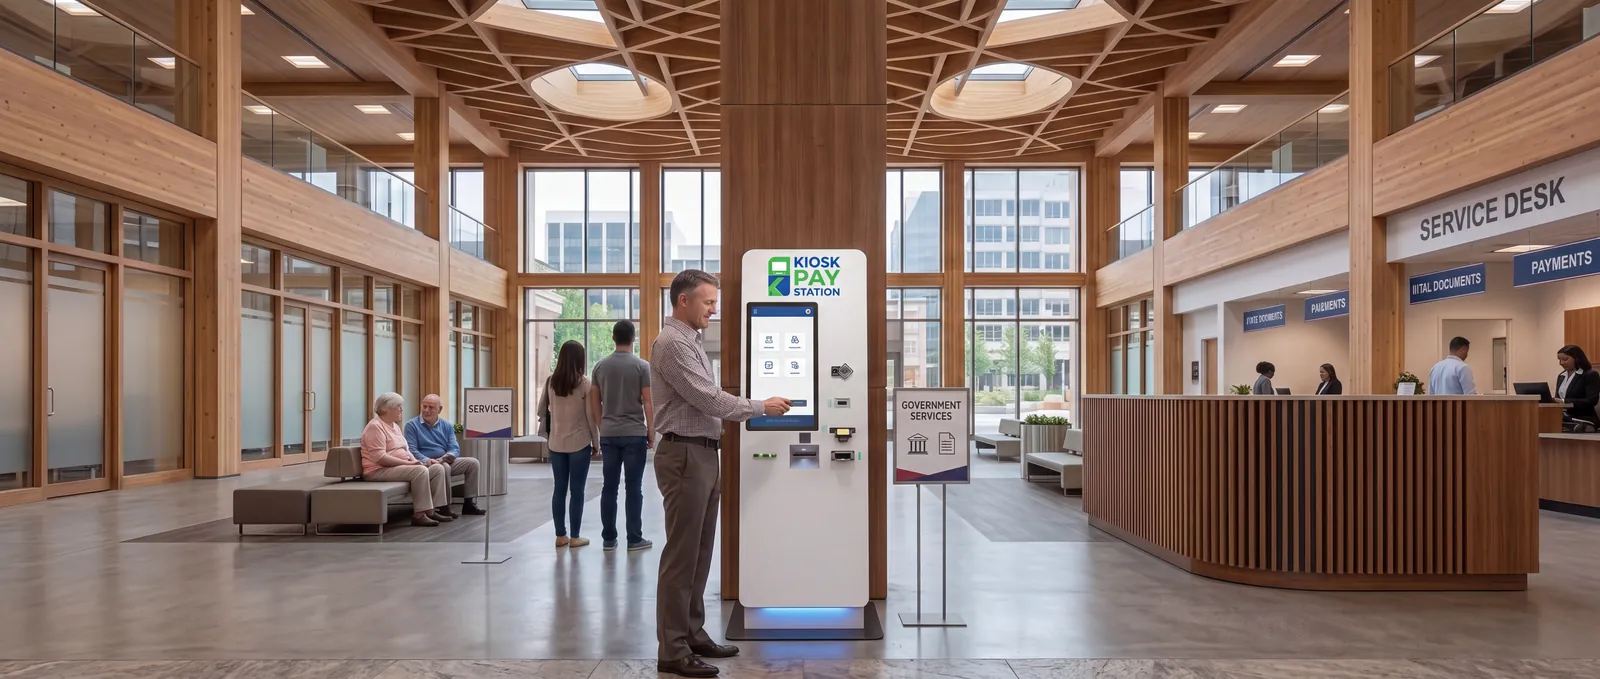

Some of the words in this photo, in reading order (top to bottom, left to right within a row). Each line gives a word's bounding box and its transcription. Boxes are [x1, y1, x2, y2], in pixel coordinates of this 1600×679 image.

[1420, 197, 1498, 241] SERVICE
[1504, 176, 1565, 218] DESK
[794, 256, 841, 268] KIOSK
[1531, 250, 1593, 275] PAYMENTS
[794, 269, 841, 286] PAY
[1433, 272, 1482, 292] DOCUMENTS
[793, 287, 841, 297] STATION
[468, 404, 509, 413] SERVICES
[901, 400, 962, 410] GOVERNMENT
[910, 411, 953, 421] SERVICES
